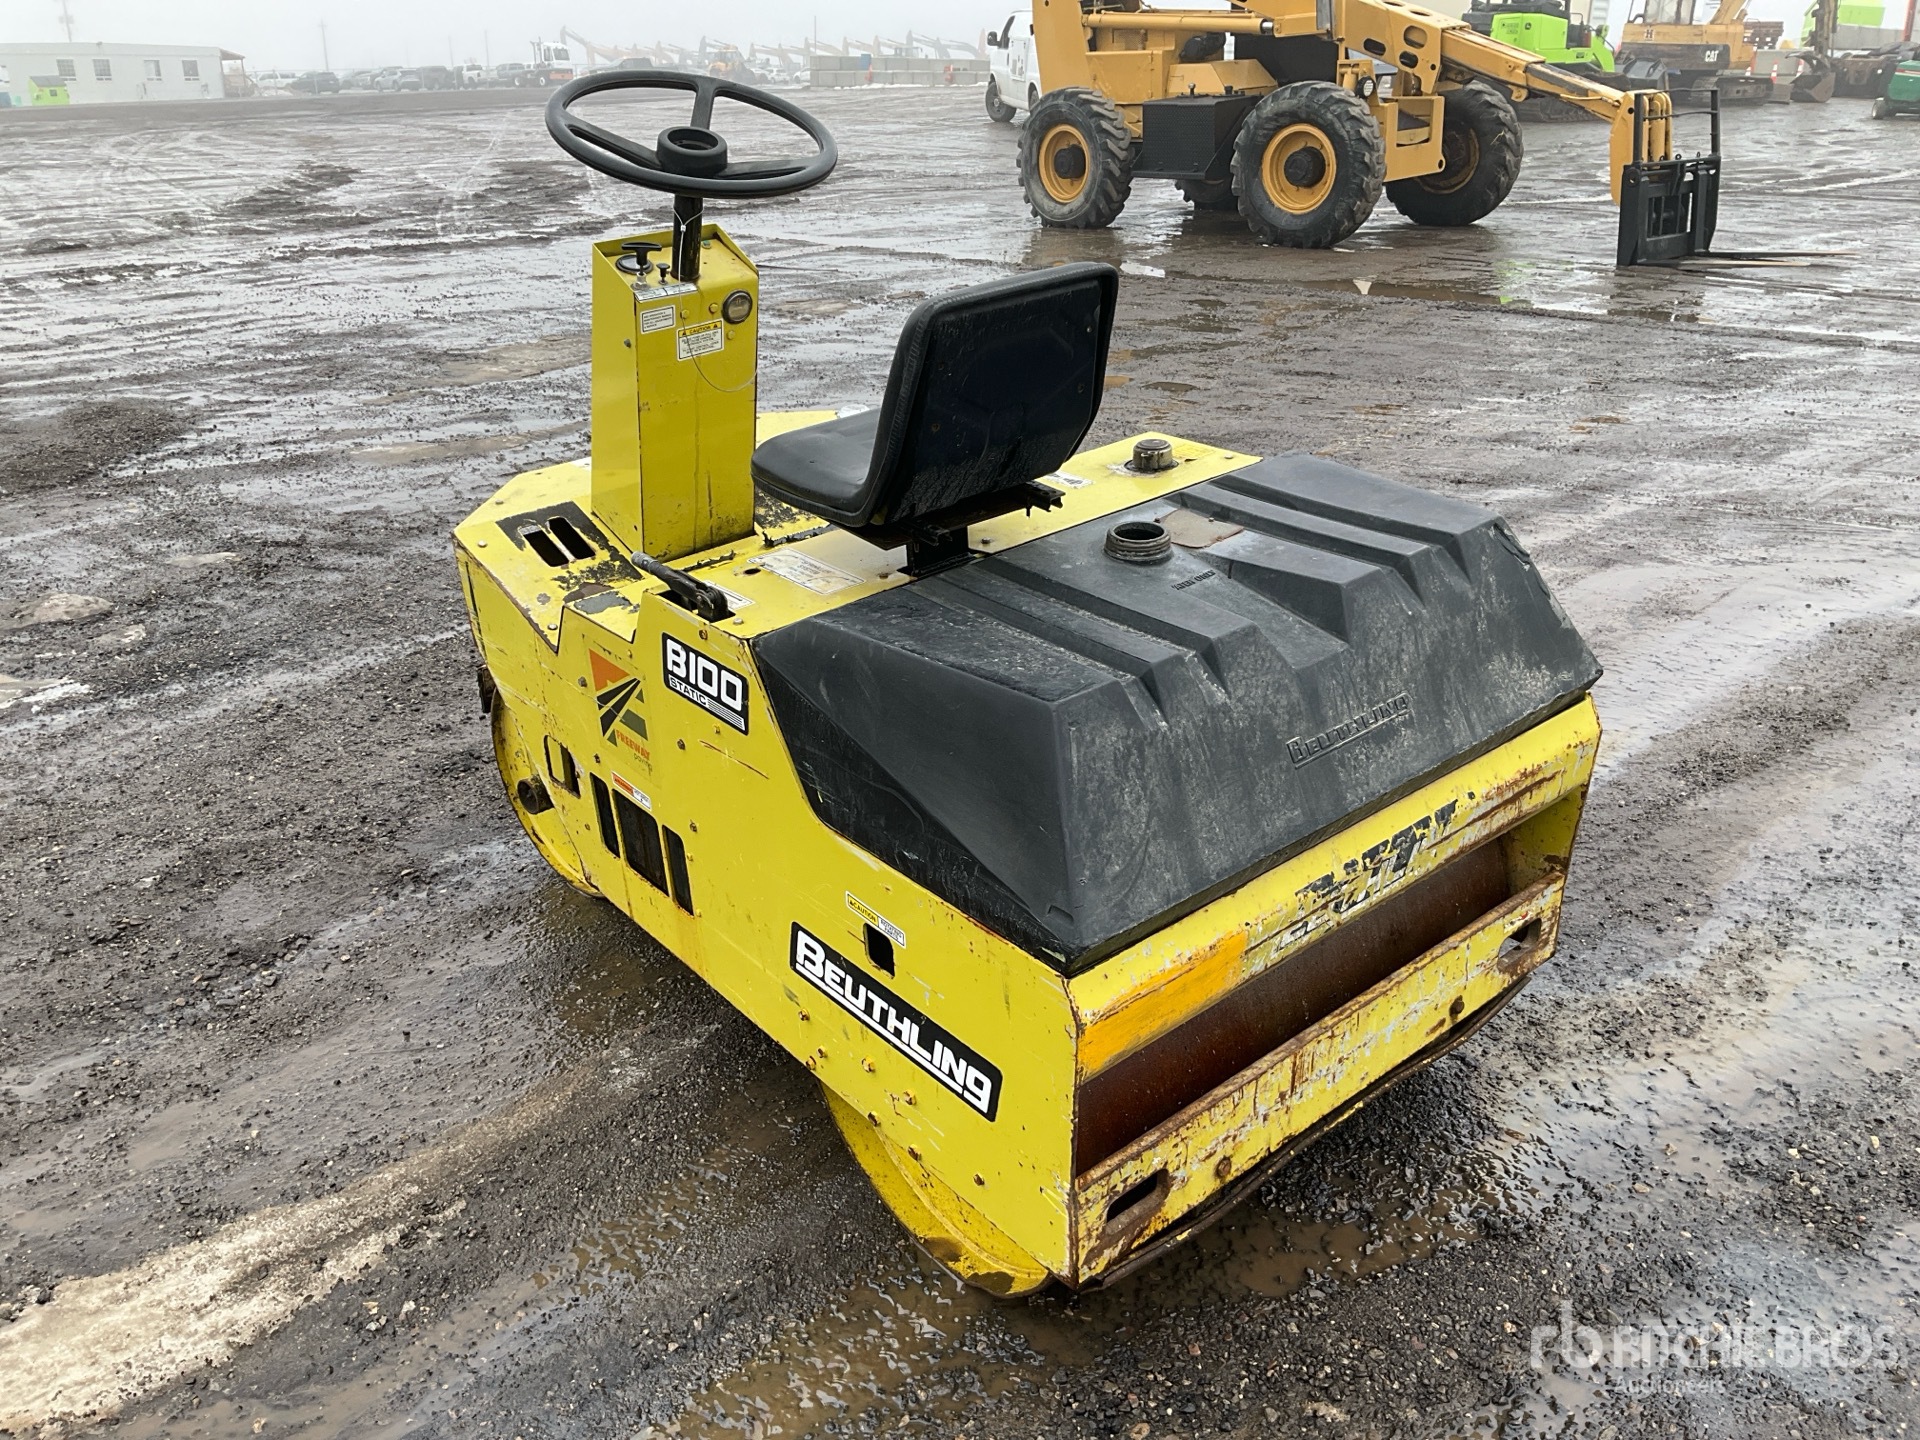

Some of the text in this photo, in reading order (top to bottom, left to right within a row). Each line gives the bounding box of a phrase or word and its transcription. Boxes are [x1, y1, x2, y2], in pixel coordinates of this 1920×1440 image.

[1705, 50, 1719, 62] CAT
[666, 638, 742, 712] B100
[669, 676, 707, 706] STATIC
[615, 729, 651, 761] FREEWAY
[853, 902, 876, 922] CAUTION
